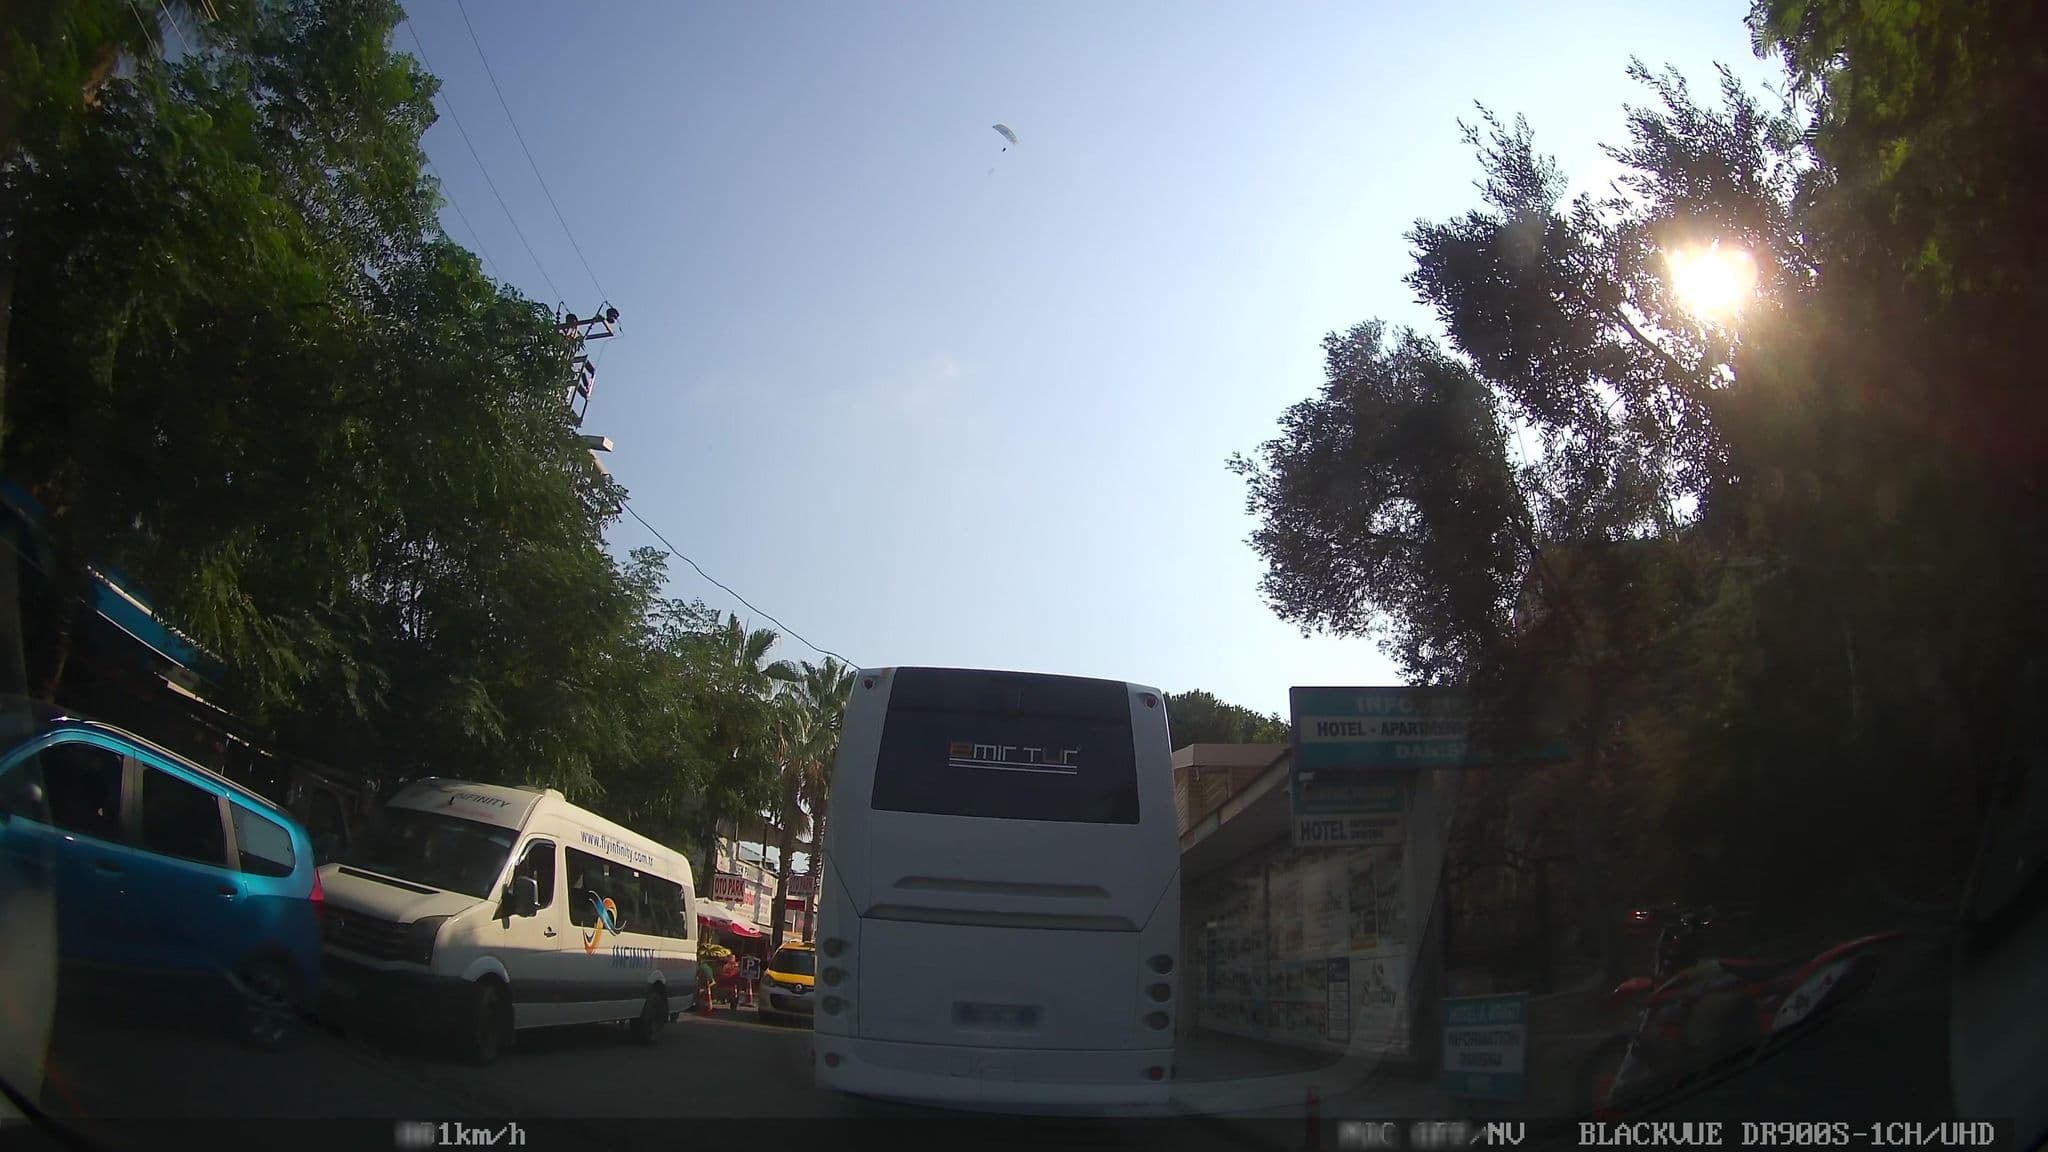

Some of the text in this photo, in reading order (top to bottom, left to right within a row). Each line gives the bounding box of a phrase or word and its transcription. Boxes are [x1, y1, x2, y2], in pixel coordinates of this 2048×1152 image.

[1317, 721, 1364, 737] HOTEL
[1302, 821, 1348, 841] HOTEL
[580, 831, 656, 867] www.flyinfinity.com.tr
[715, 878, 746, 897] OTO PARK
[610, 945, 655, 968] INFINITY
